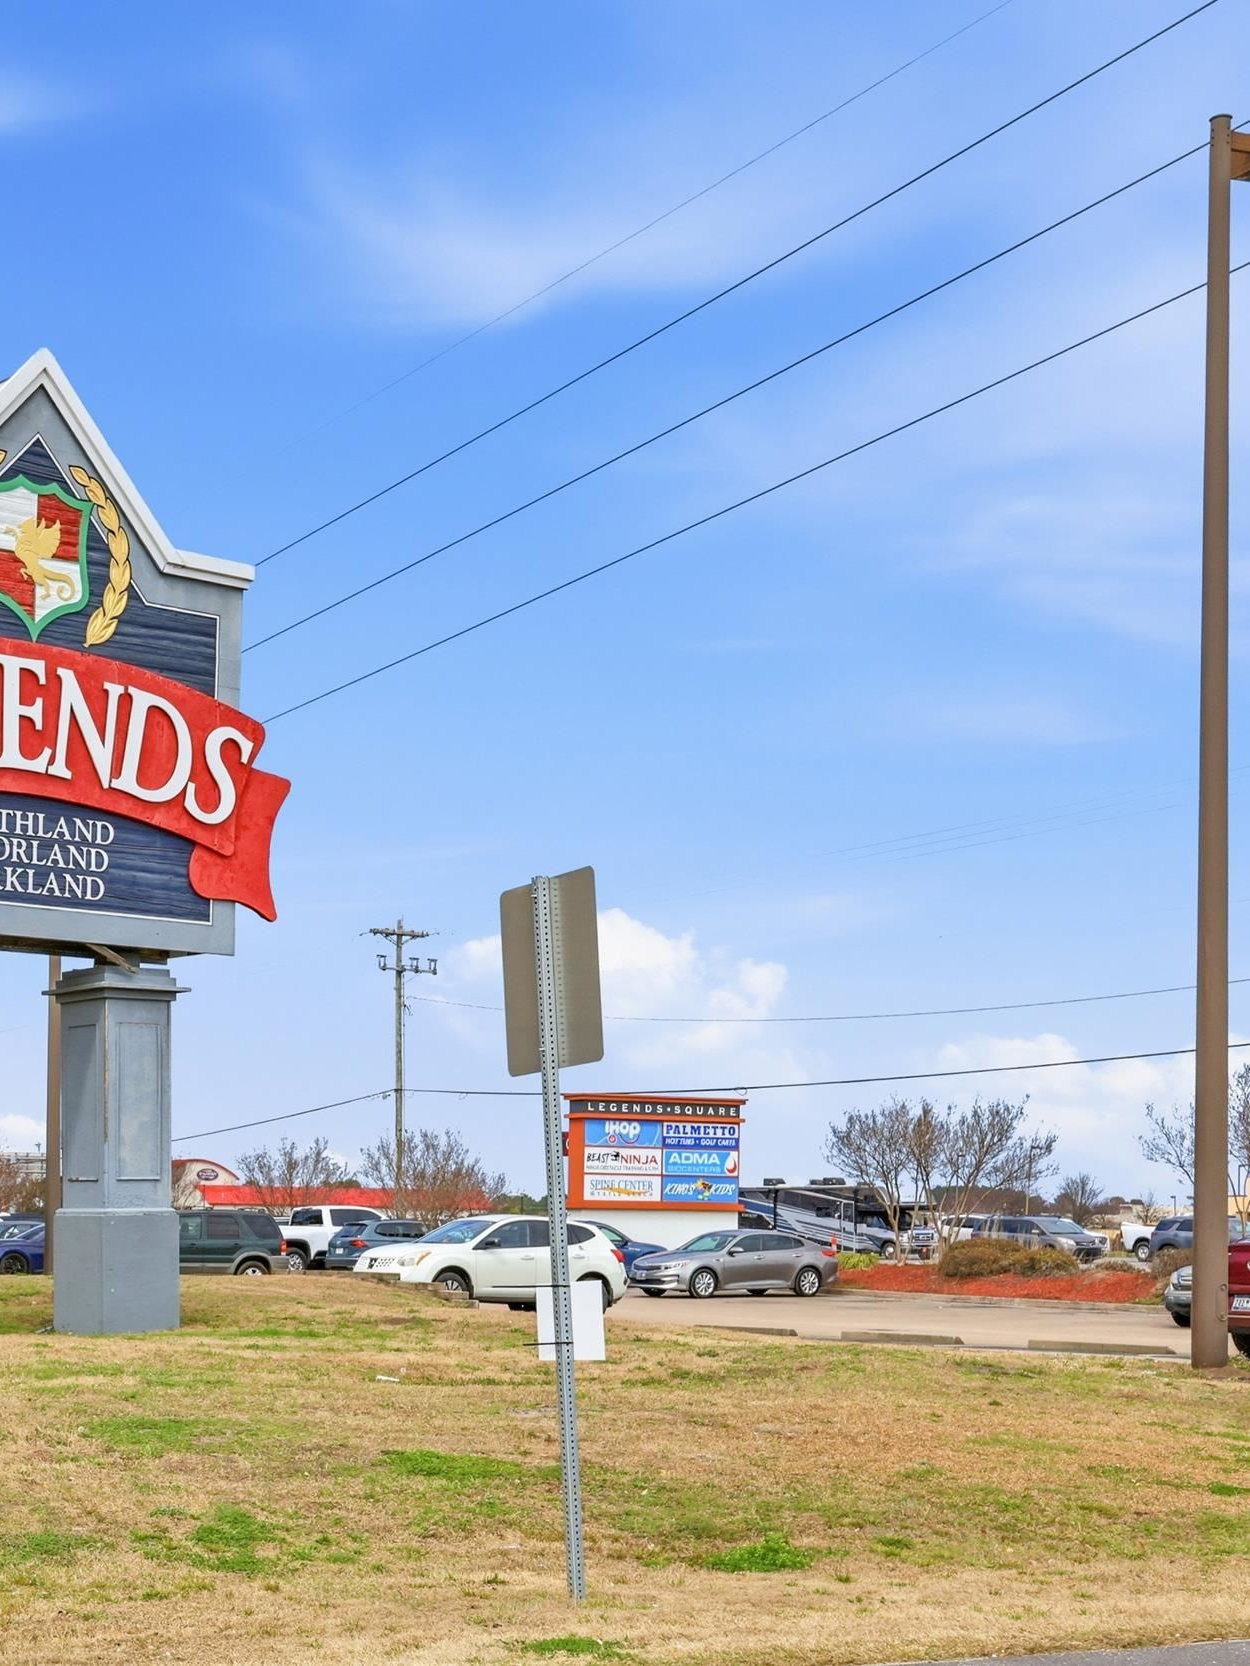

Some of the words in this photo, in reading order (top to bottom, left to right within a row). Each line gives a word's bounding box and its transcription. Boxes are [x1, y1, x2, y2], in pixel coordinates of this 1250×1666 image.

[587, 1102, 663, 1114] LEGENDS
[674, 1105, 737, 1116] SQUARE
[665, 1124, 736, 1136] PALMETTO
[700, 1138, 717, 1146] GOLF
[587, 1153, 610, 1164] BEAST
[621, 1154, 658, 1165] NINJA
[669, 1152, 721, 1165] ADMA
[667, 1165, 721, 1173] BIOCENTERS
[590, 1179, 616, 1191] SPINE
[617, 1180, 654, 1192] CENTER
[710, 1183, 736, 1196] KIDS
